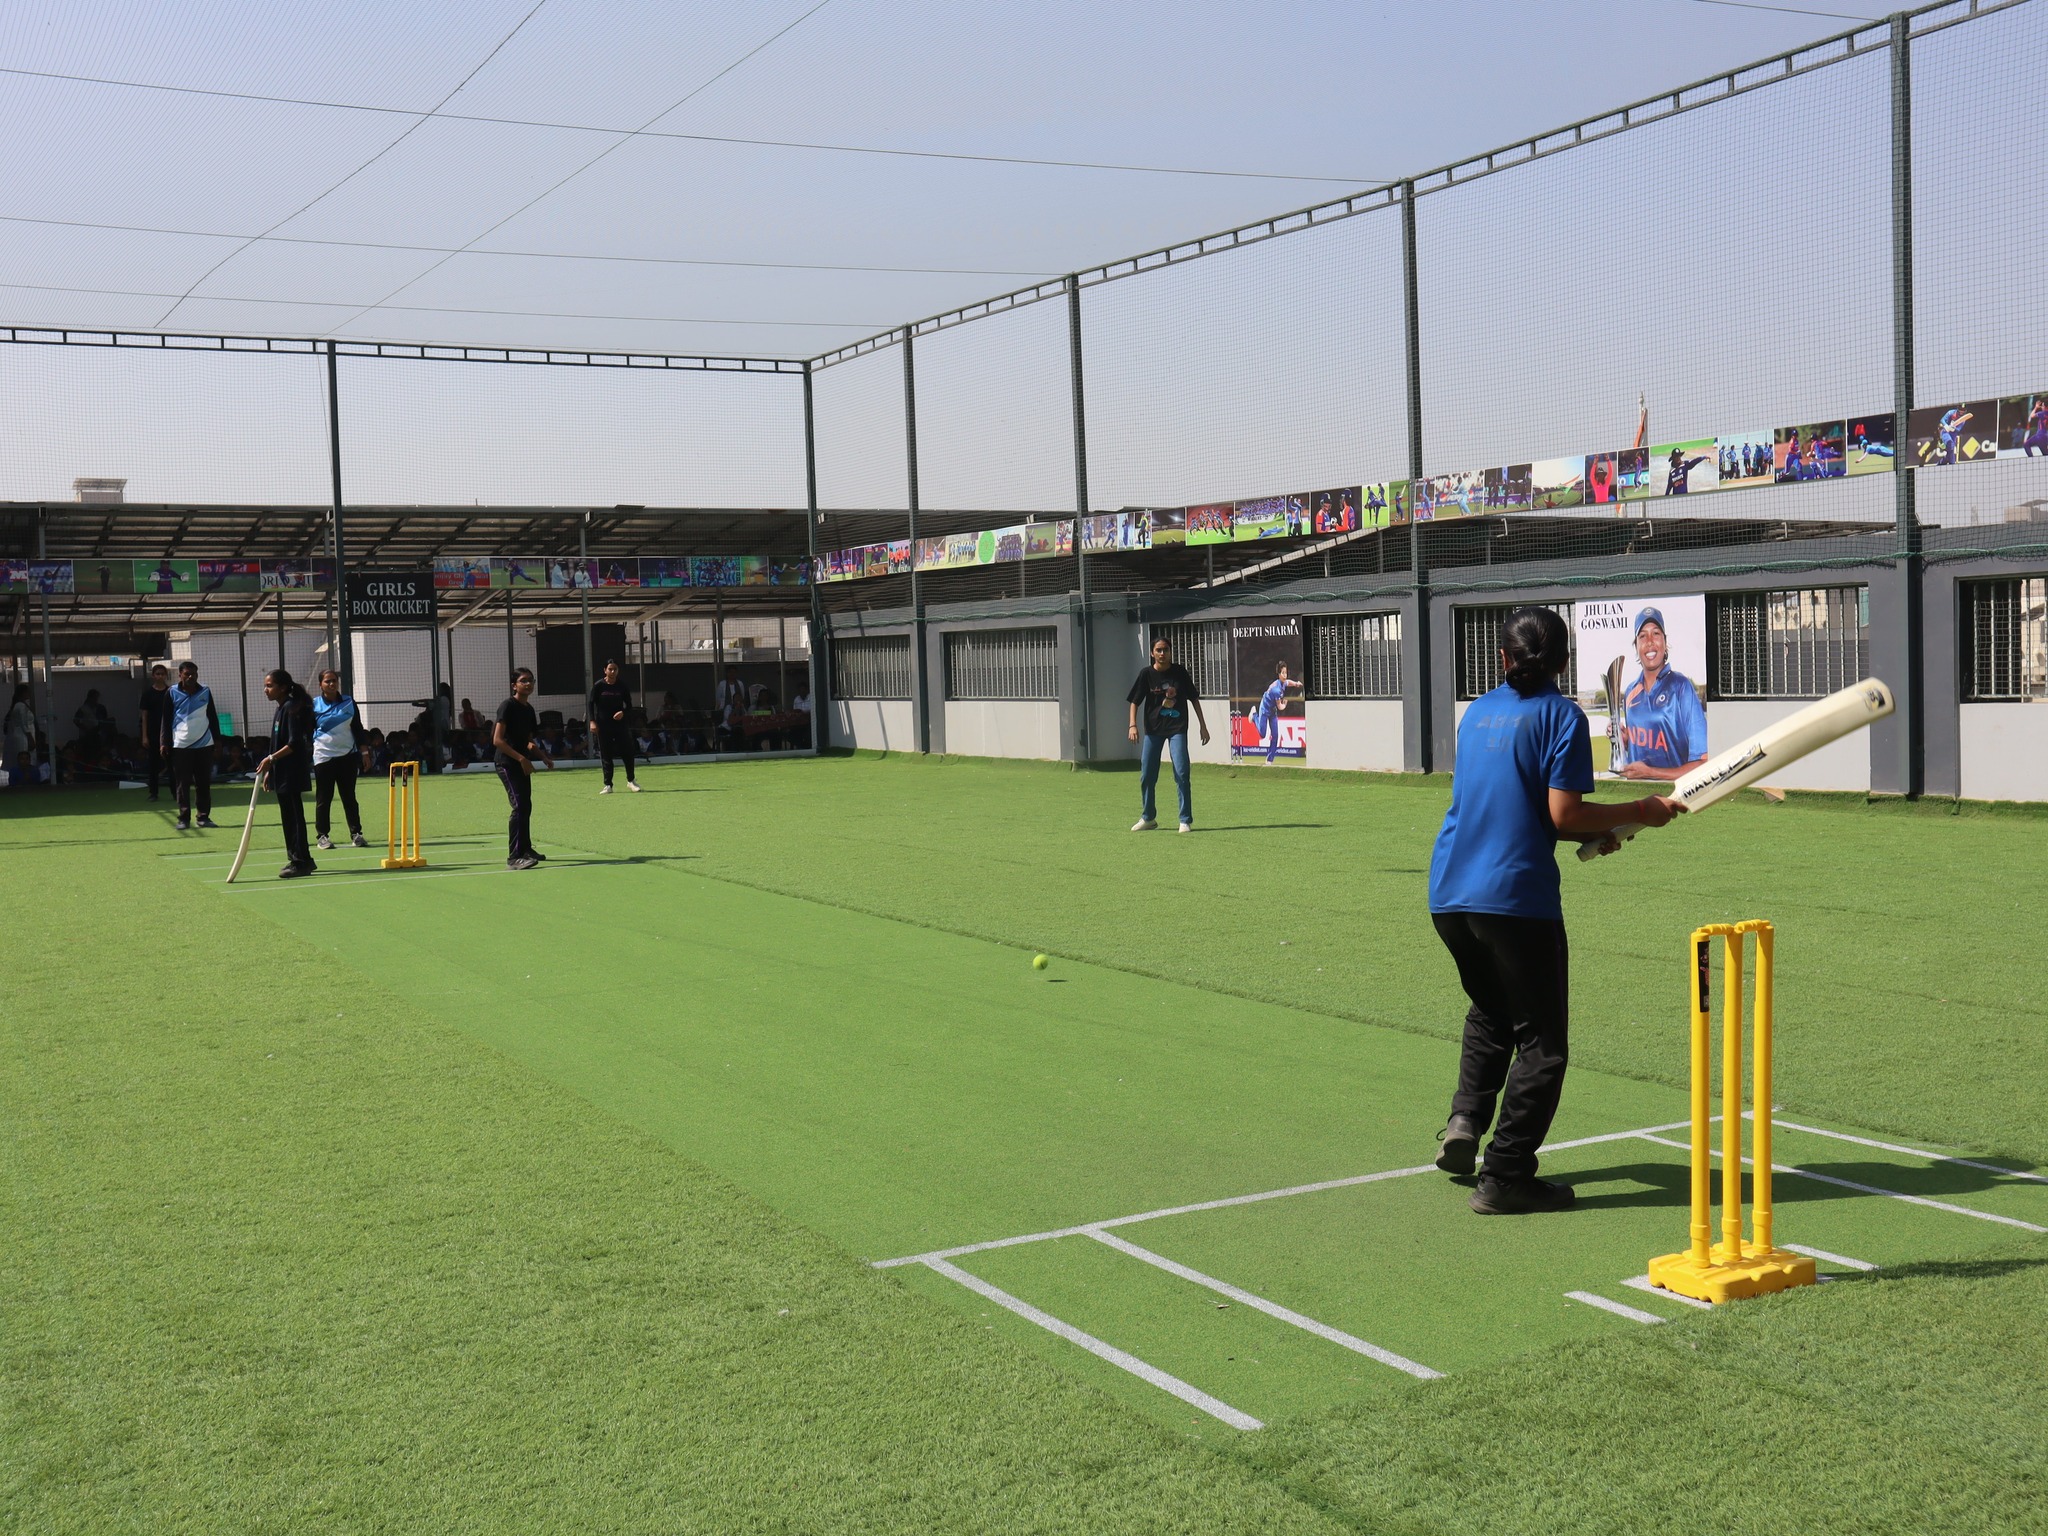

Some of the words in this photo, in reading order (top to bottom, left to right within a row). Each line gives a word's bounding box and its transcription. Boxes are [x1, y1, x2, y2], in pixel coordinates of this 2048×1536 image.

[366, 582, 416, 597] GIRLS
[352, 600, 378, 615] BOX
[380, 599, 431, 615] CRICKET
[1583, 602, 1624, 617] JHULAN
[1232, 626, 1263, 638] DEEPTI
[1264, 624, 1299, 637] SHARMA
[1580, 617, 1629, 630] GOSWAMI
[1627, 726, 1669, 753] NDIA
